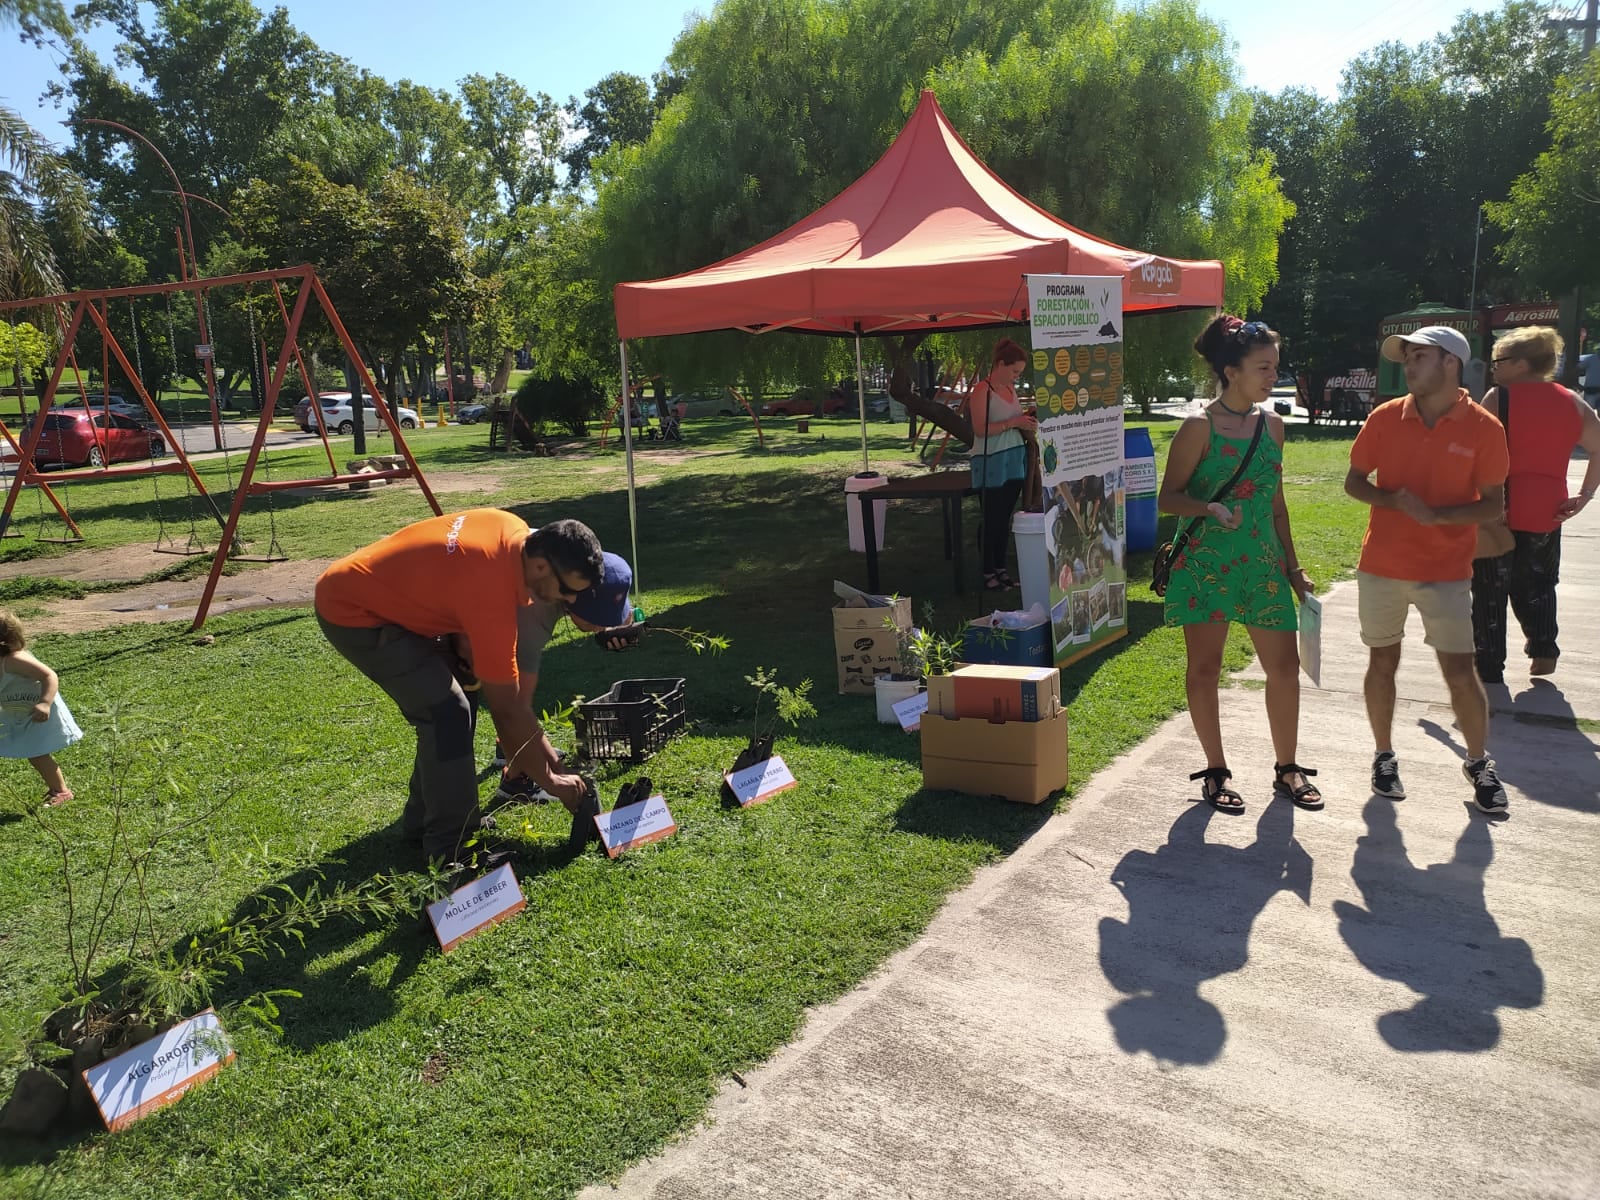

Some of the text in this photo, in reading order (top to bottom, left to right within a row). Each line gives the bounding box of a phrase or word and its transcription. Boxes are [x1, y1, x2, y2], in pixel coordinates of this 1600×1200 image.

[1047, 285, 1085, 296] PROGRAMA
[1037, 298, 1089, 311] FORESTACIÓN
[1033, 311, 1099, 327] ESPACIO PÚBLICO
[1382, 324, 1399, 335] CITY
[1401, 321, 1422, 333] TOUR
[1326, 371, 1377, 389] Aerosilla
[603, 818, 634, 833] MANZANO
[633, 815, 645, 823] DEL
[645, 807, 666, 819] CAMPO
[445, 900, 472, 920] MOLLE
[472, 894, 484, 905] DE
[484, 880, 508, 899] BEBER
[128, 1038, 198, 1083] ALGARROBO
